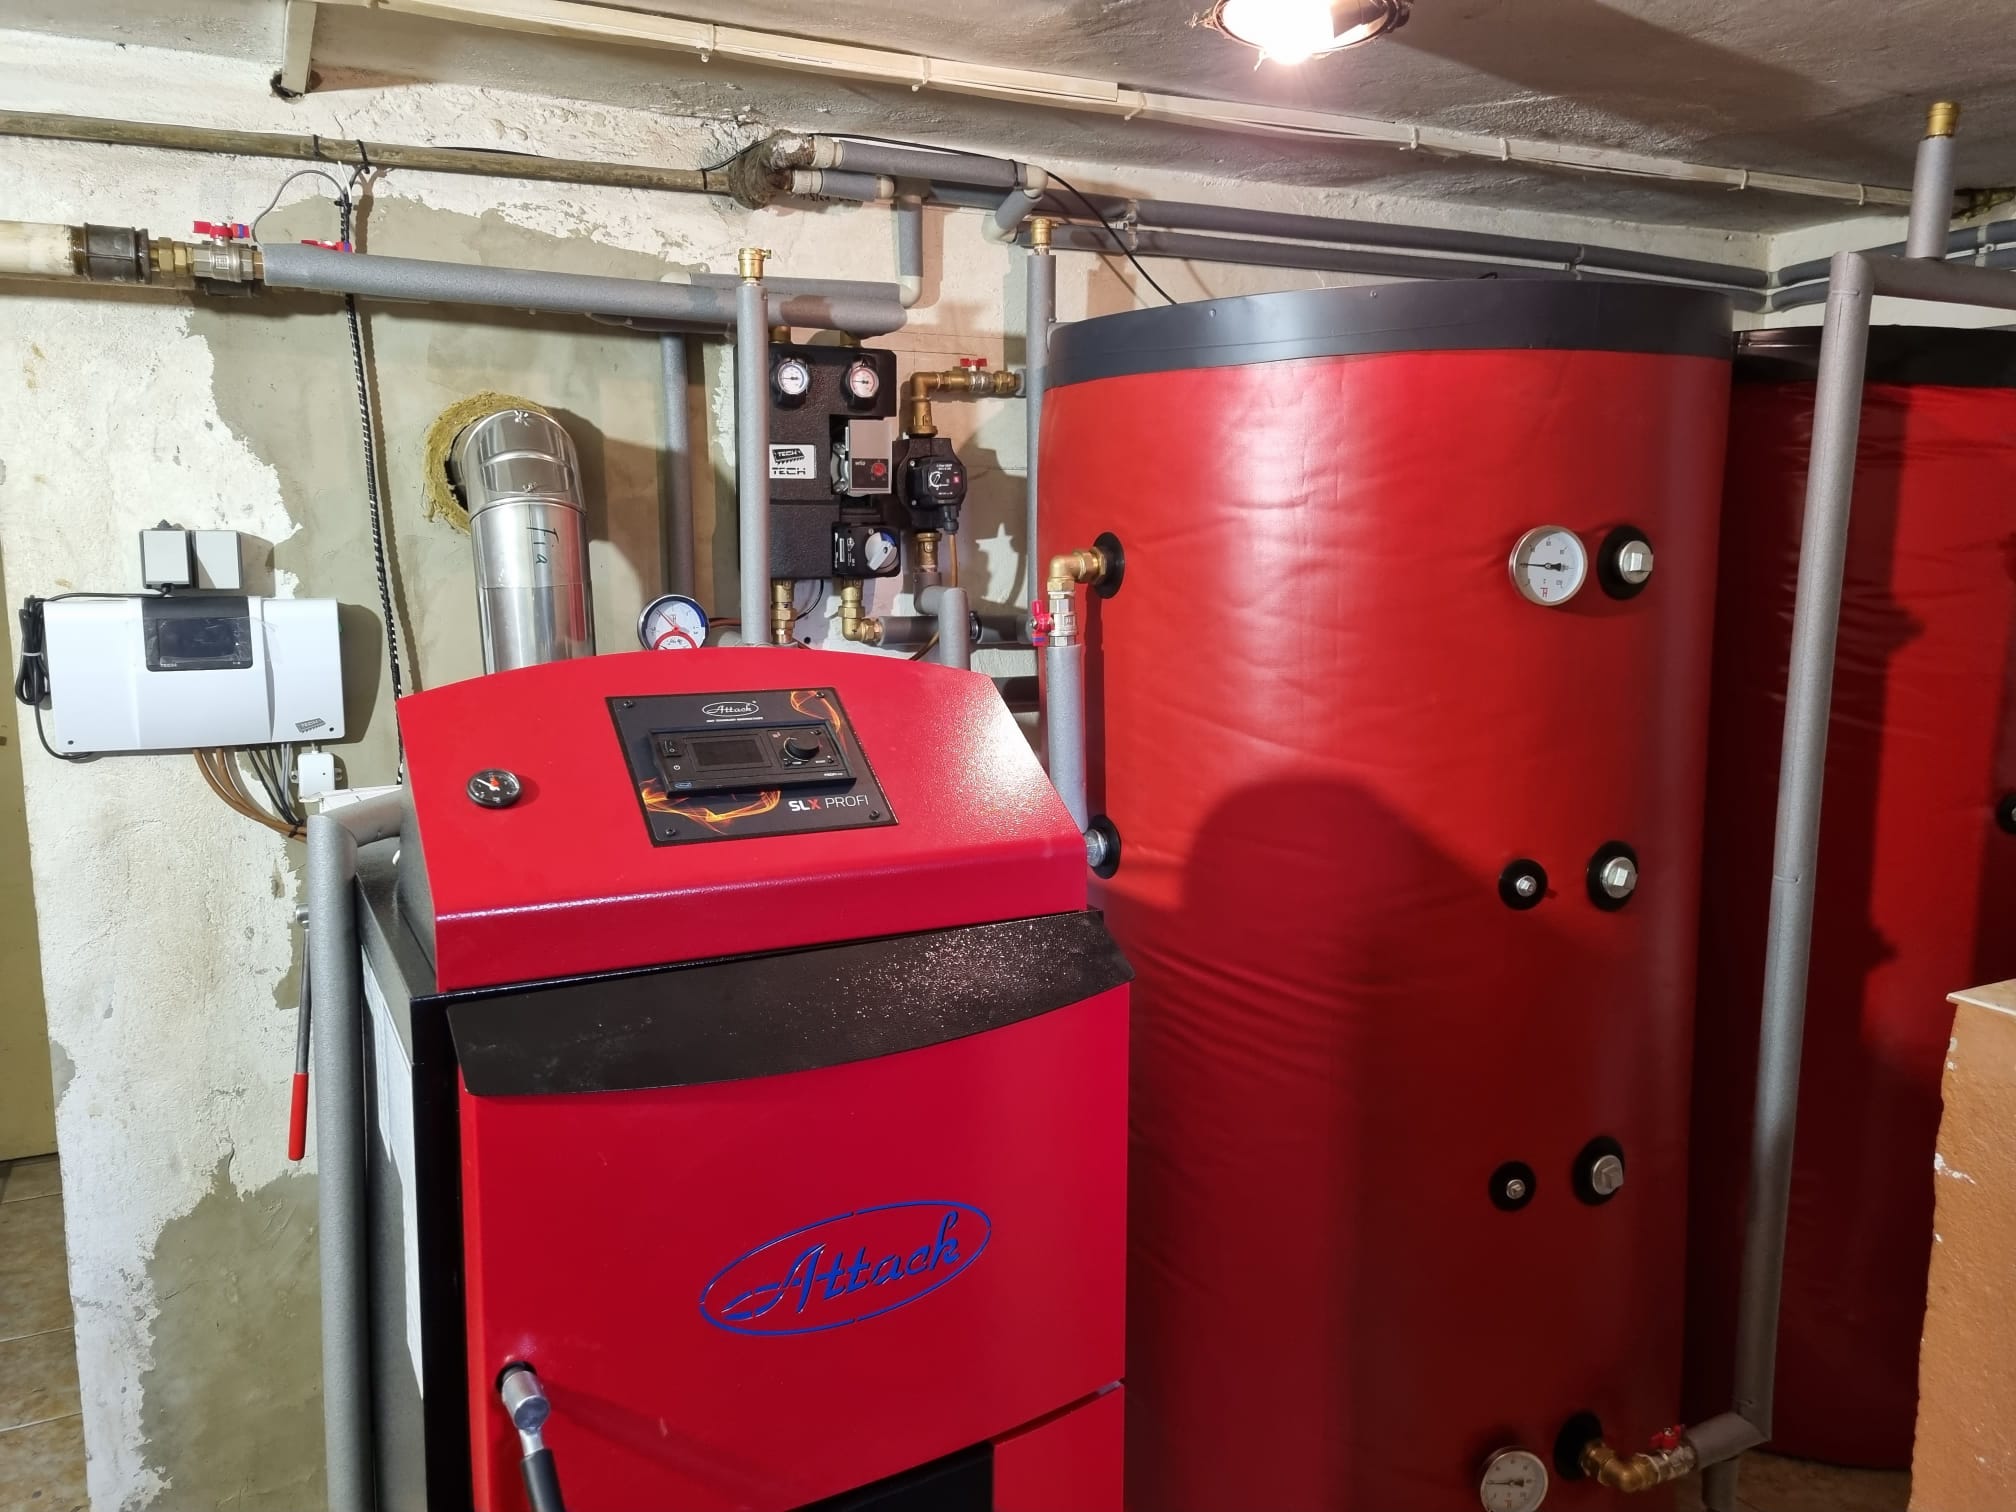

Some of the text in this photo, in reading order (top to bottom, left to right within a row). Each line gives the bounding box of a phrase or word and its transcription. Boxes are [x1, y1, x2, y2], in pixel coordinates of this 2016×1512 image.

[771, 467, 806, 475] TECH
[706, 703, 753, 714] Attack
[788, 794, 869, 812] SLX PROFI
[721, 1209, 961, 1321] Attack
